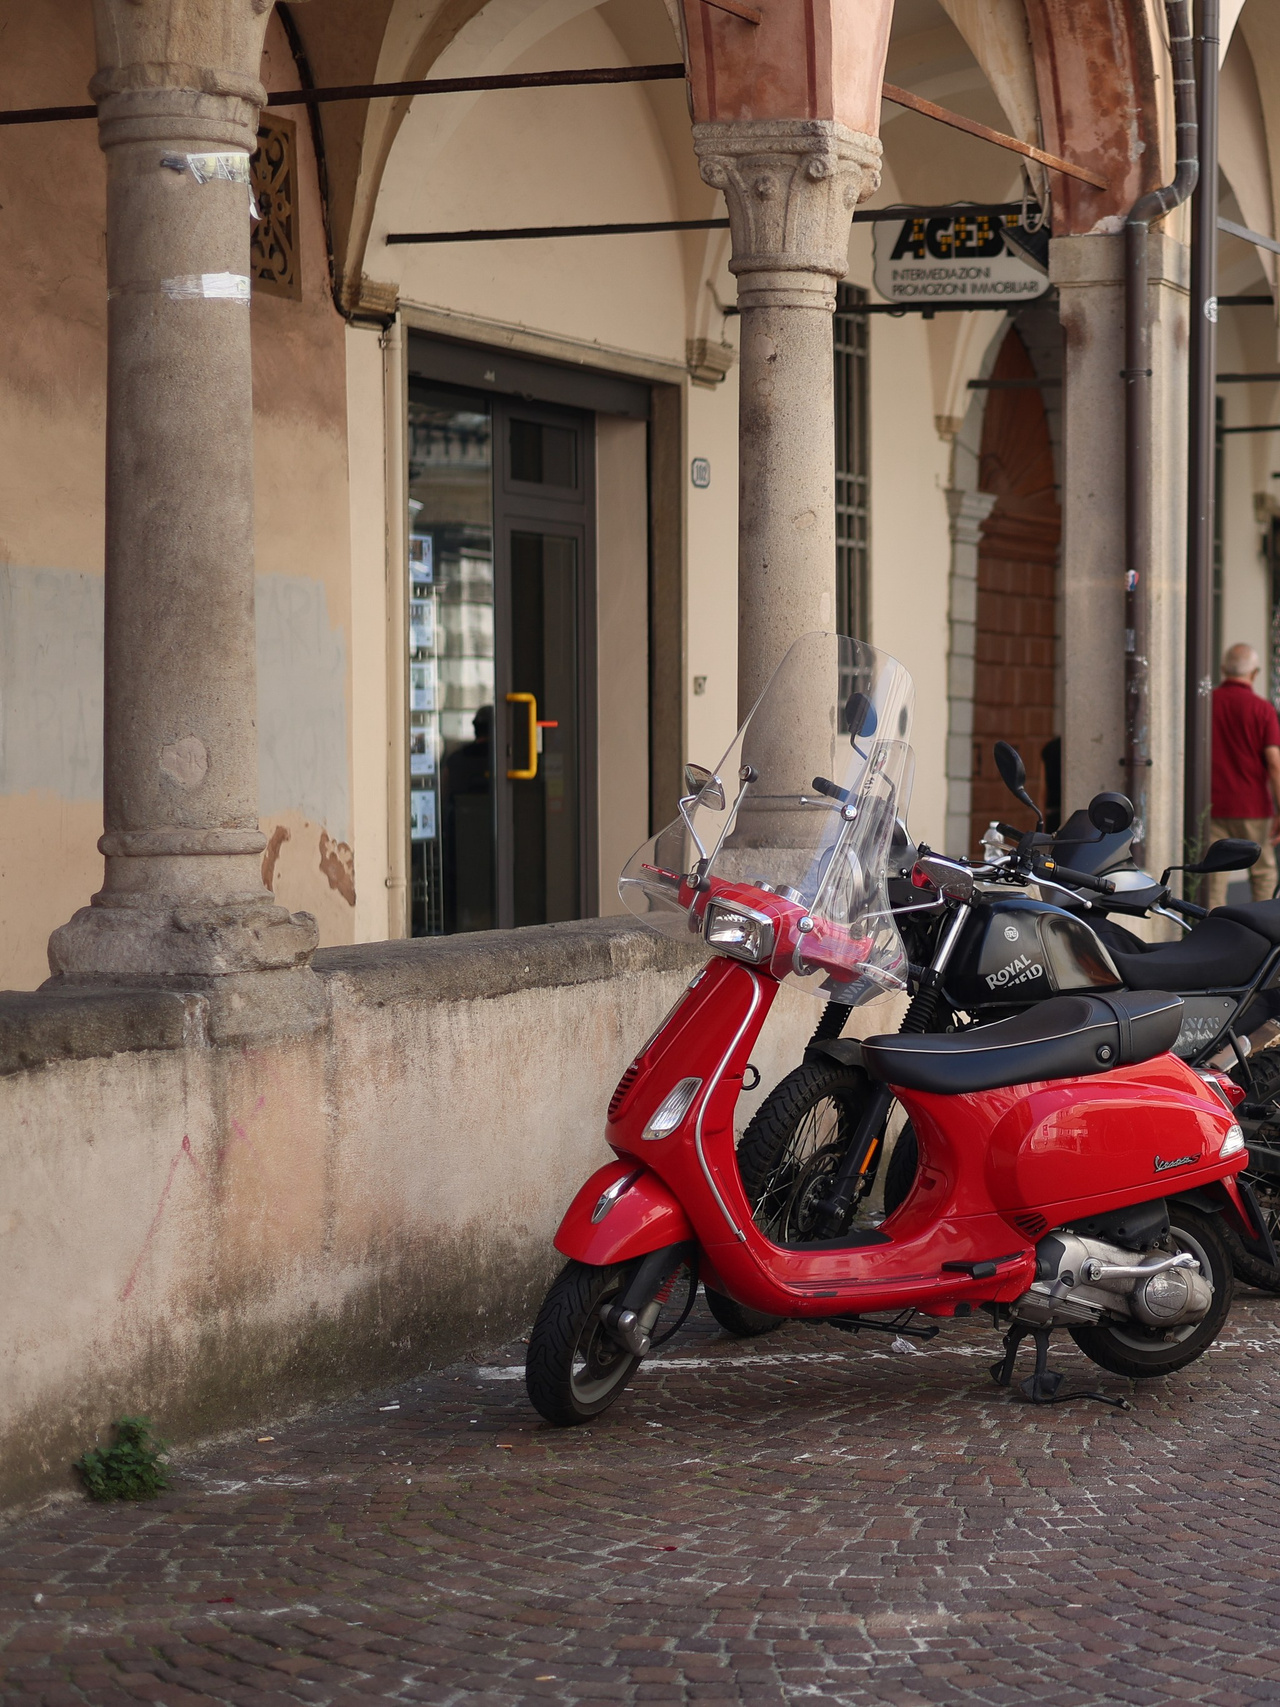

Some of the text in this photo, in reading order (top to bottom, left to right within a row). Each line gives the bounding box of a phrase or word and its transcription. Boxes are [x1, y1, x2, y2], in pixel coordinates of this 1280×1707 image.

[891, 266, 991, 281] INTERMEDIAZIONI
[891, 281, 1039, 296] PROMOZIONI IMMOBILIARI
[985, 954, 1031, 990] ROYAL
